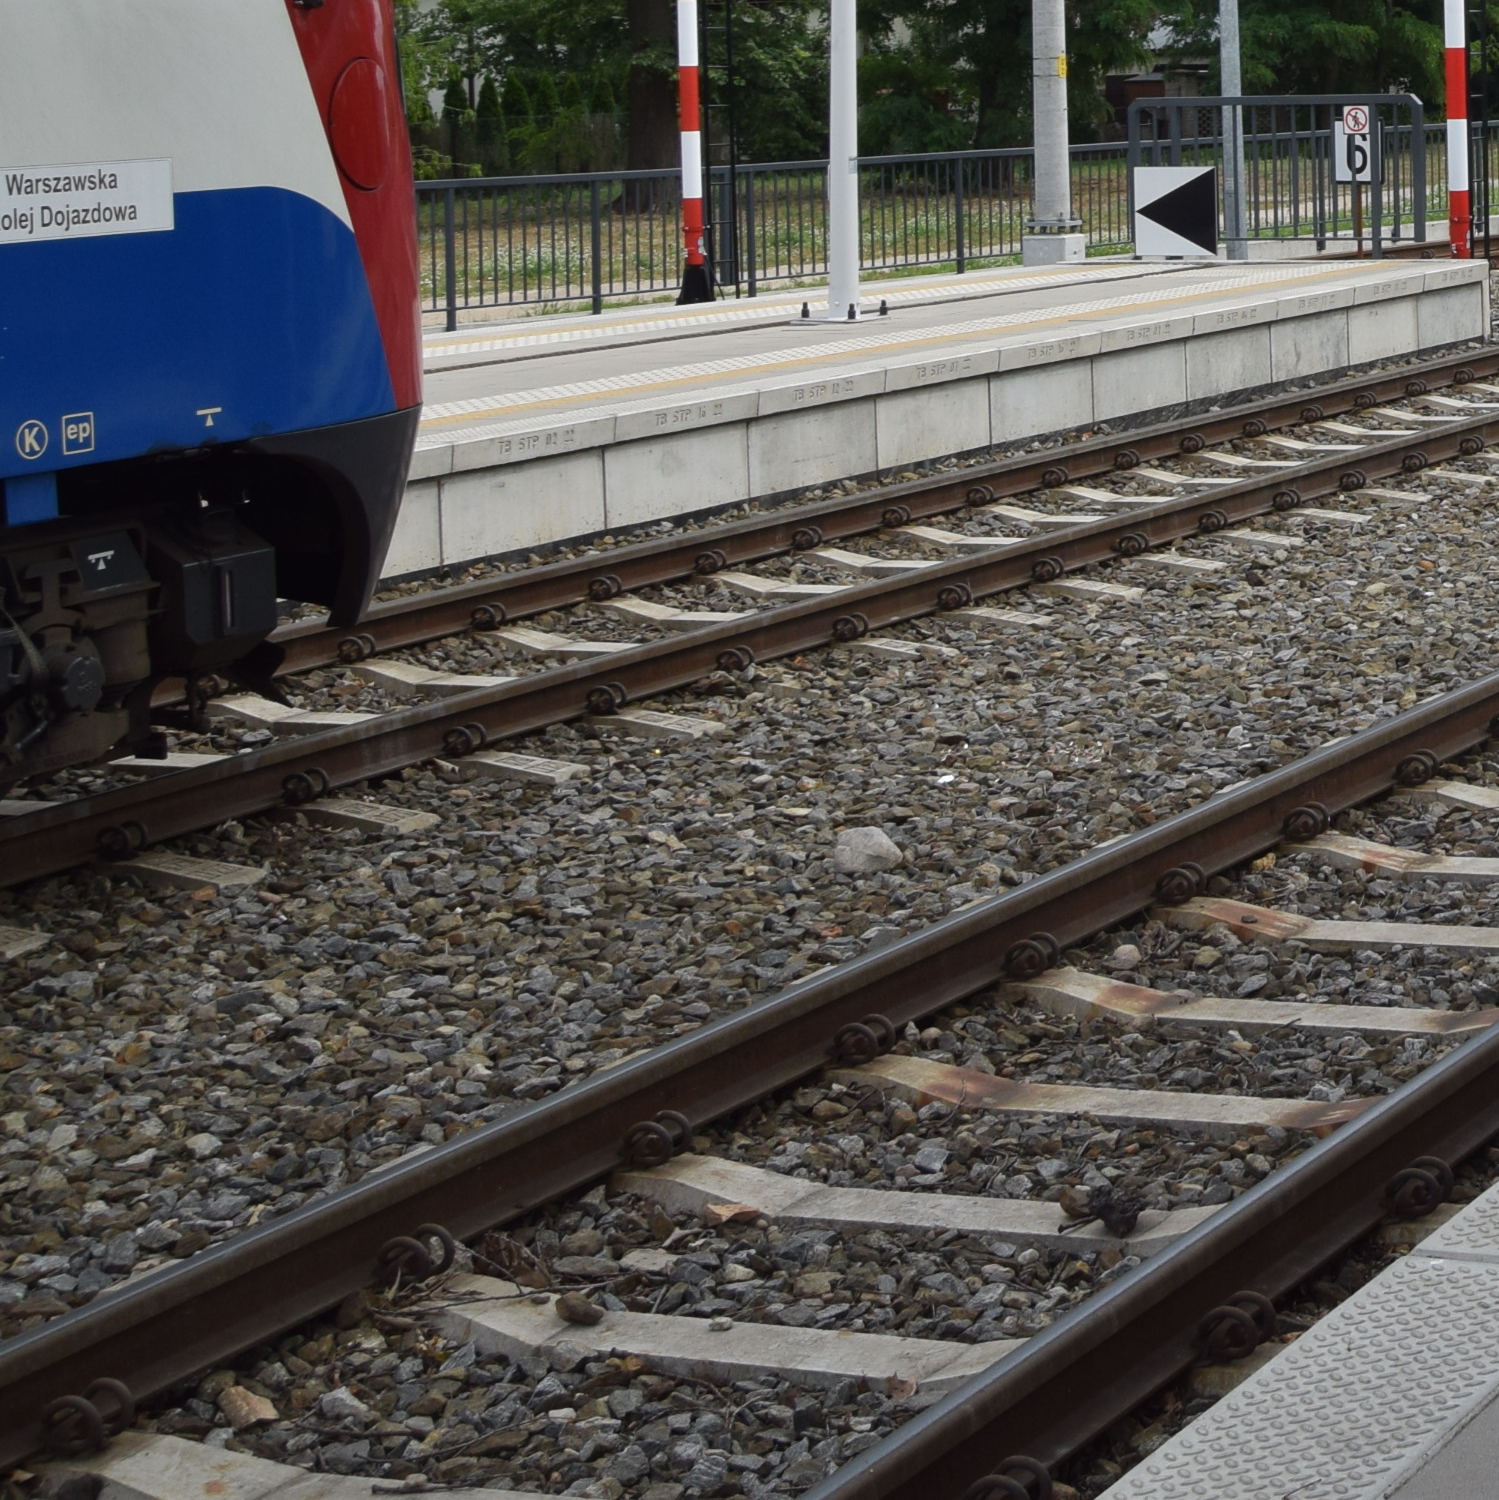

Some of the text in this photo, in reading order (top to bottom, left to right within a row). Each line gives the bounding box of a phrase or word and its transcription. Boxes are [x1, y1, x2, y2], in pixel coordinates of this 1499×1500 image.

[1346, 133, 1368, 175] 6
[5, 168, 118, 196] Warszawska
[0, 201, 137, 234] olej Dojazdowa
[655, 412, 667, 426] TB
[673, 408, 692, 423] STP
[24, 426, 41, 453] K
[66, 422, 91, 443] ep
[497, 440, 512, 455] TB
[518, 435, 540, 451] STP
